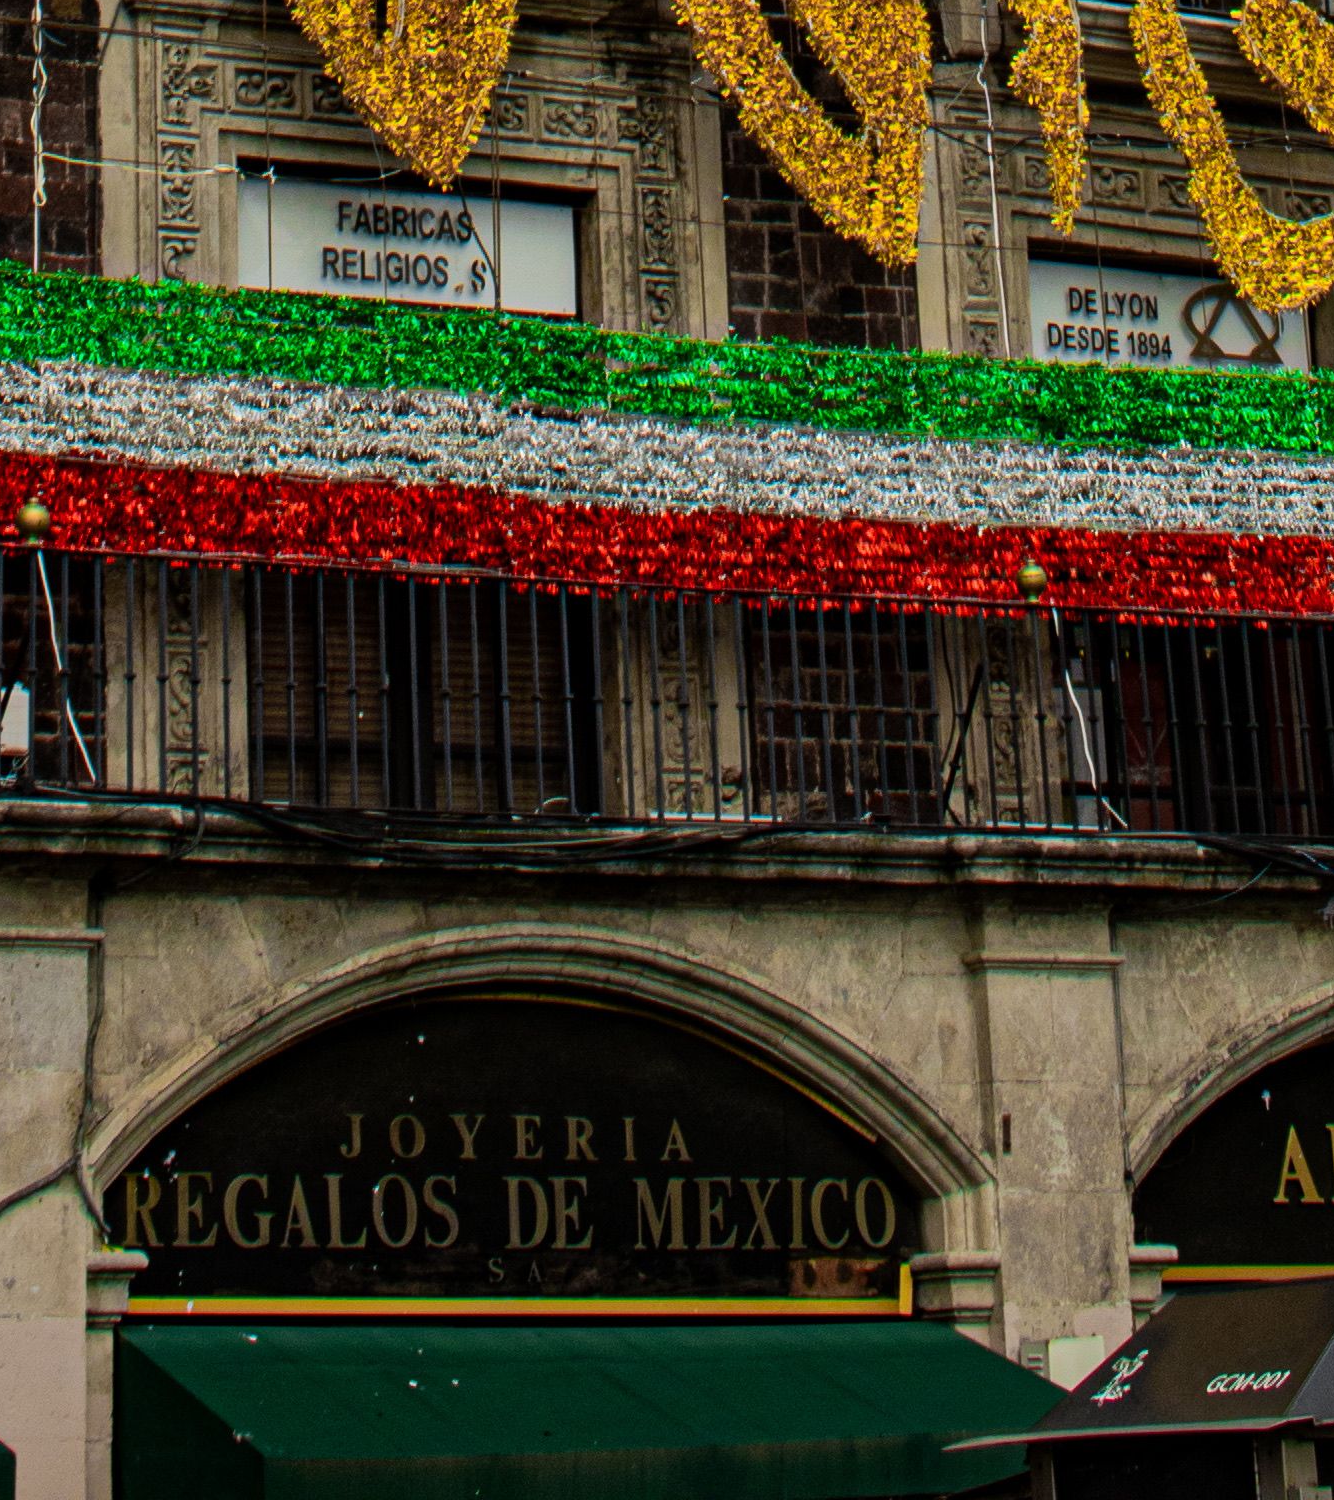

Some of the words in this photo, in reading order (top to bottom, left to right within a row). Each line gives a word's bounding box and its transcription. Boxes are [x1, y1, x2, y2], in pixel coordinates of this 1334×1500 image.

[337, 200, 473, 242] FABRICAS
[321, 246, 487, 293] RELIGIOSS
[1069, 287, 1098, 315] DE
[1104, 291, 1159, 320] LYON
[1047, 323, 1121, 354] DESDE
[1127, 331, 1173, 359] 1894
[339, 1113, 693, 1162] JOYERIA
[124, 1171, 461, 1251] REGALOS
[504, 1175, 594, 1251] DE
[634, 1175, 897, 1251] MEXICO
